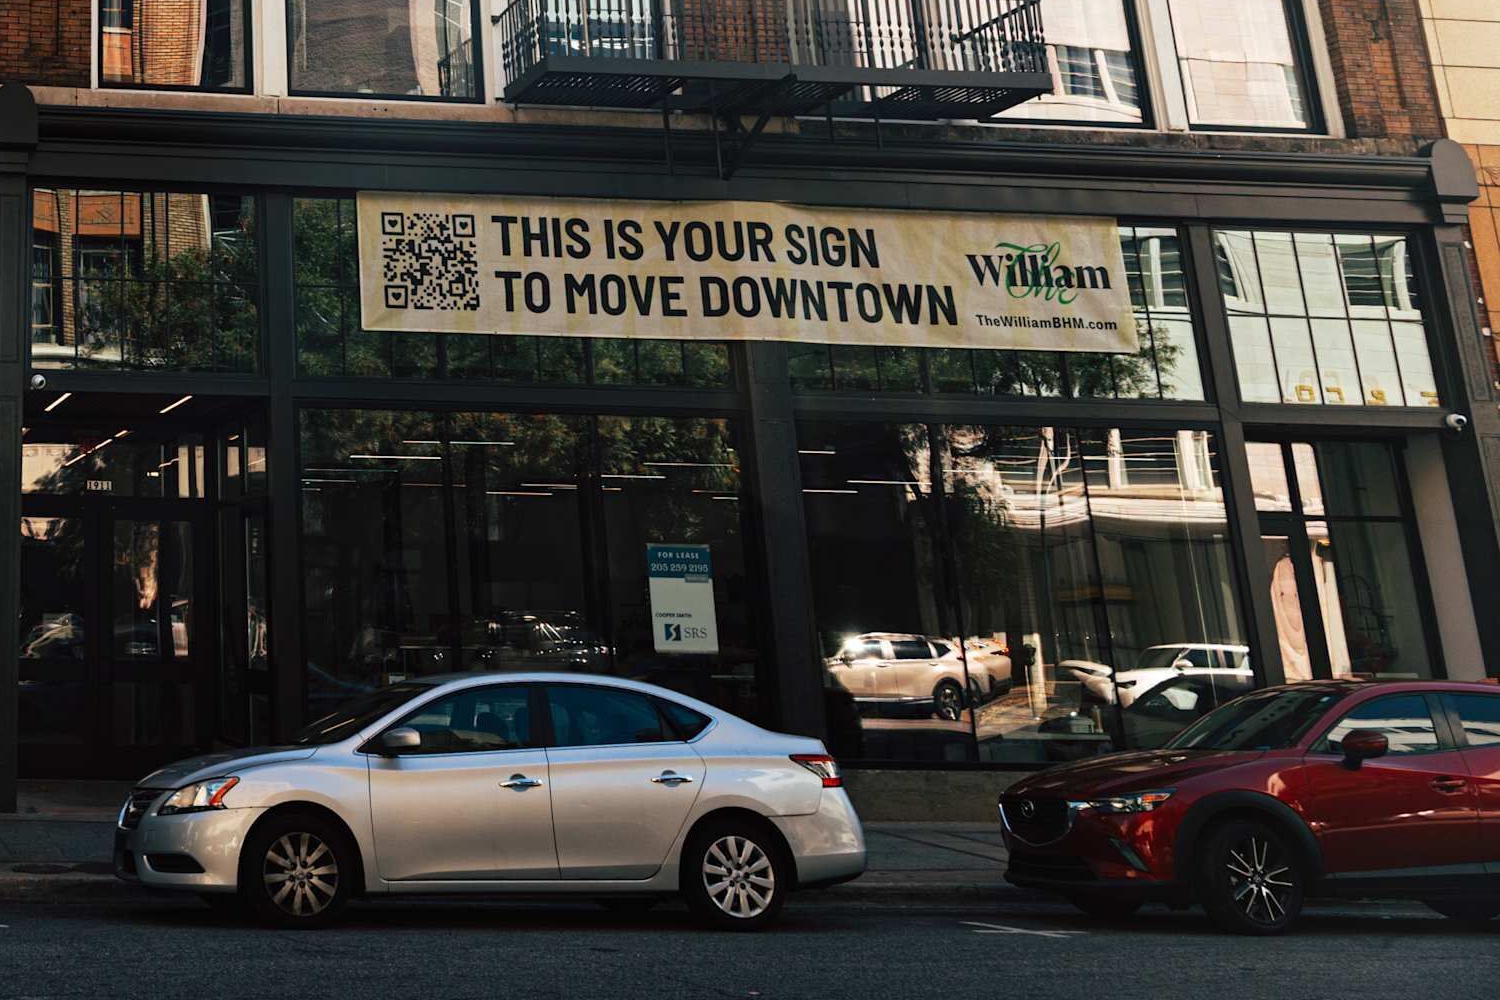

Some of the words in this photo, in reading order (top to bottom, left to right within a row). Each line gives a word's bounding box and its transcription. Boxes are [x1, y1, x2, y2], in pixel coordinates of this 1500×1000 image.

[491, 215, 592, 259] THIS
[604, 219, 644, 259] IS
[653, 220, 776, 264] YOUR
[784, 225, 881, 268] SIGN
[965, 252, 1113, 290] William
[494, 271, 551, 314] TO
[565, 273, 690, 319] MOVE
[701, 275, 959, 327] DOWNTOWN
[975, 314, 1118, 331] TheWilliamBHM.com
[657, 551, 674, 559] FOR
[676, 552, 699, 560] LEASE
[651, 562, 668, 572] 205
[684, 628, 707, 639] SRS
